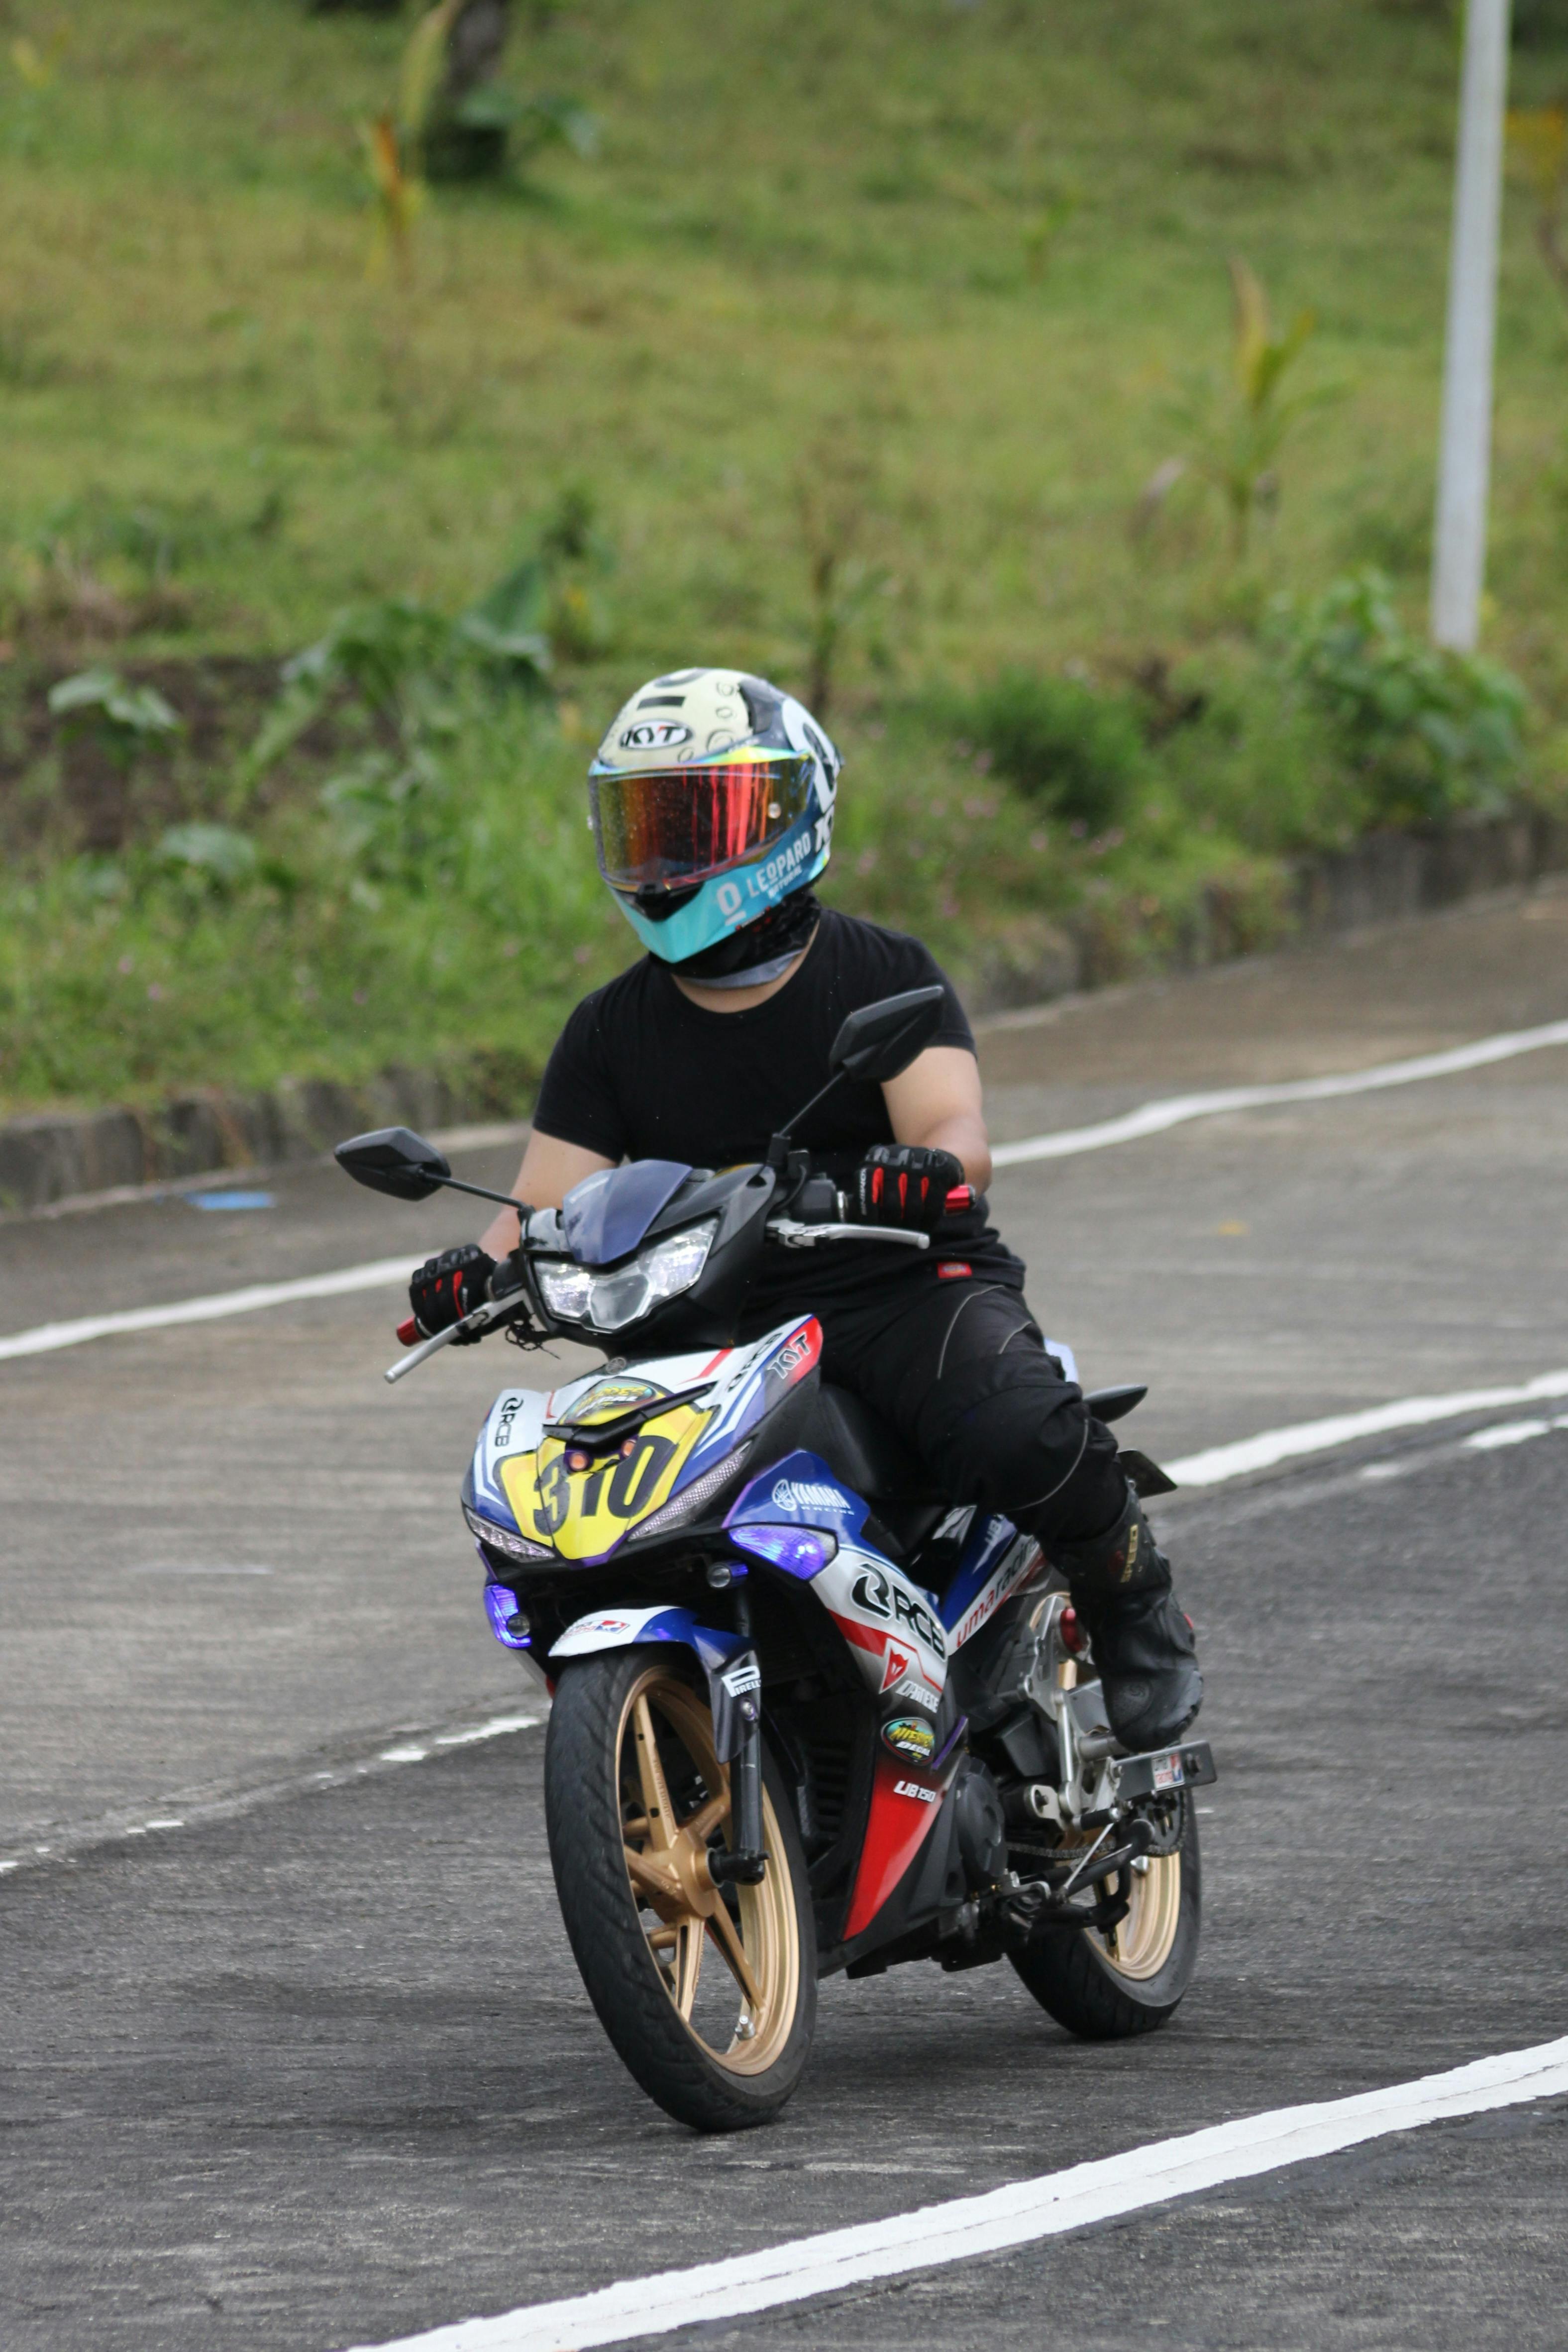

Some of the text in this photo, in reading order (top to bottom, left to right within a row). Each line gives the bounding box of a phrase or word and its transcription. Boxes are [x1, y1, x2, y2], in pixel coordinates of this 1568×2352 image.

[623, 725, 681, 747] KYT
[746, 832, 812, 897] LEOPARD
[767, 1332, 811, 1379] KYT
[533, 1435, 679, 1537] 310
[791, 1482, 851, 1509] YAMAHA
[801, 1505, 854, 1515] RACING
[896, 1680, 940, 1713] DAINESE
[896, 1741, 931, 1756] DECAL
